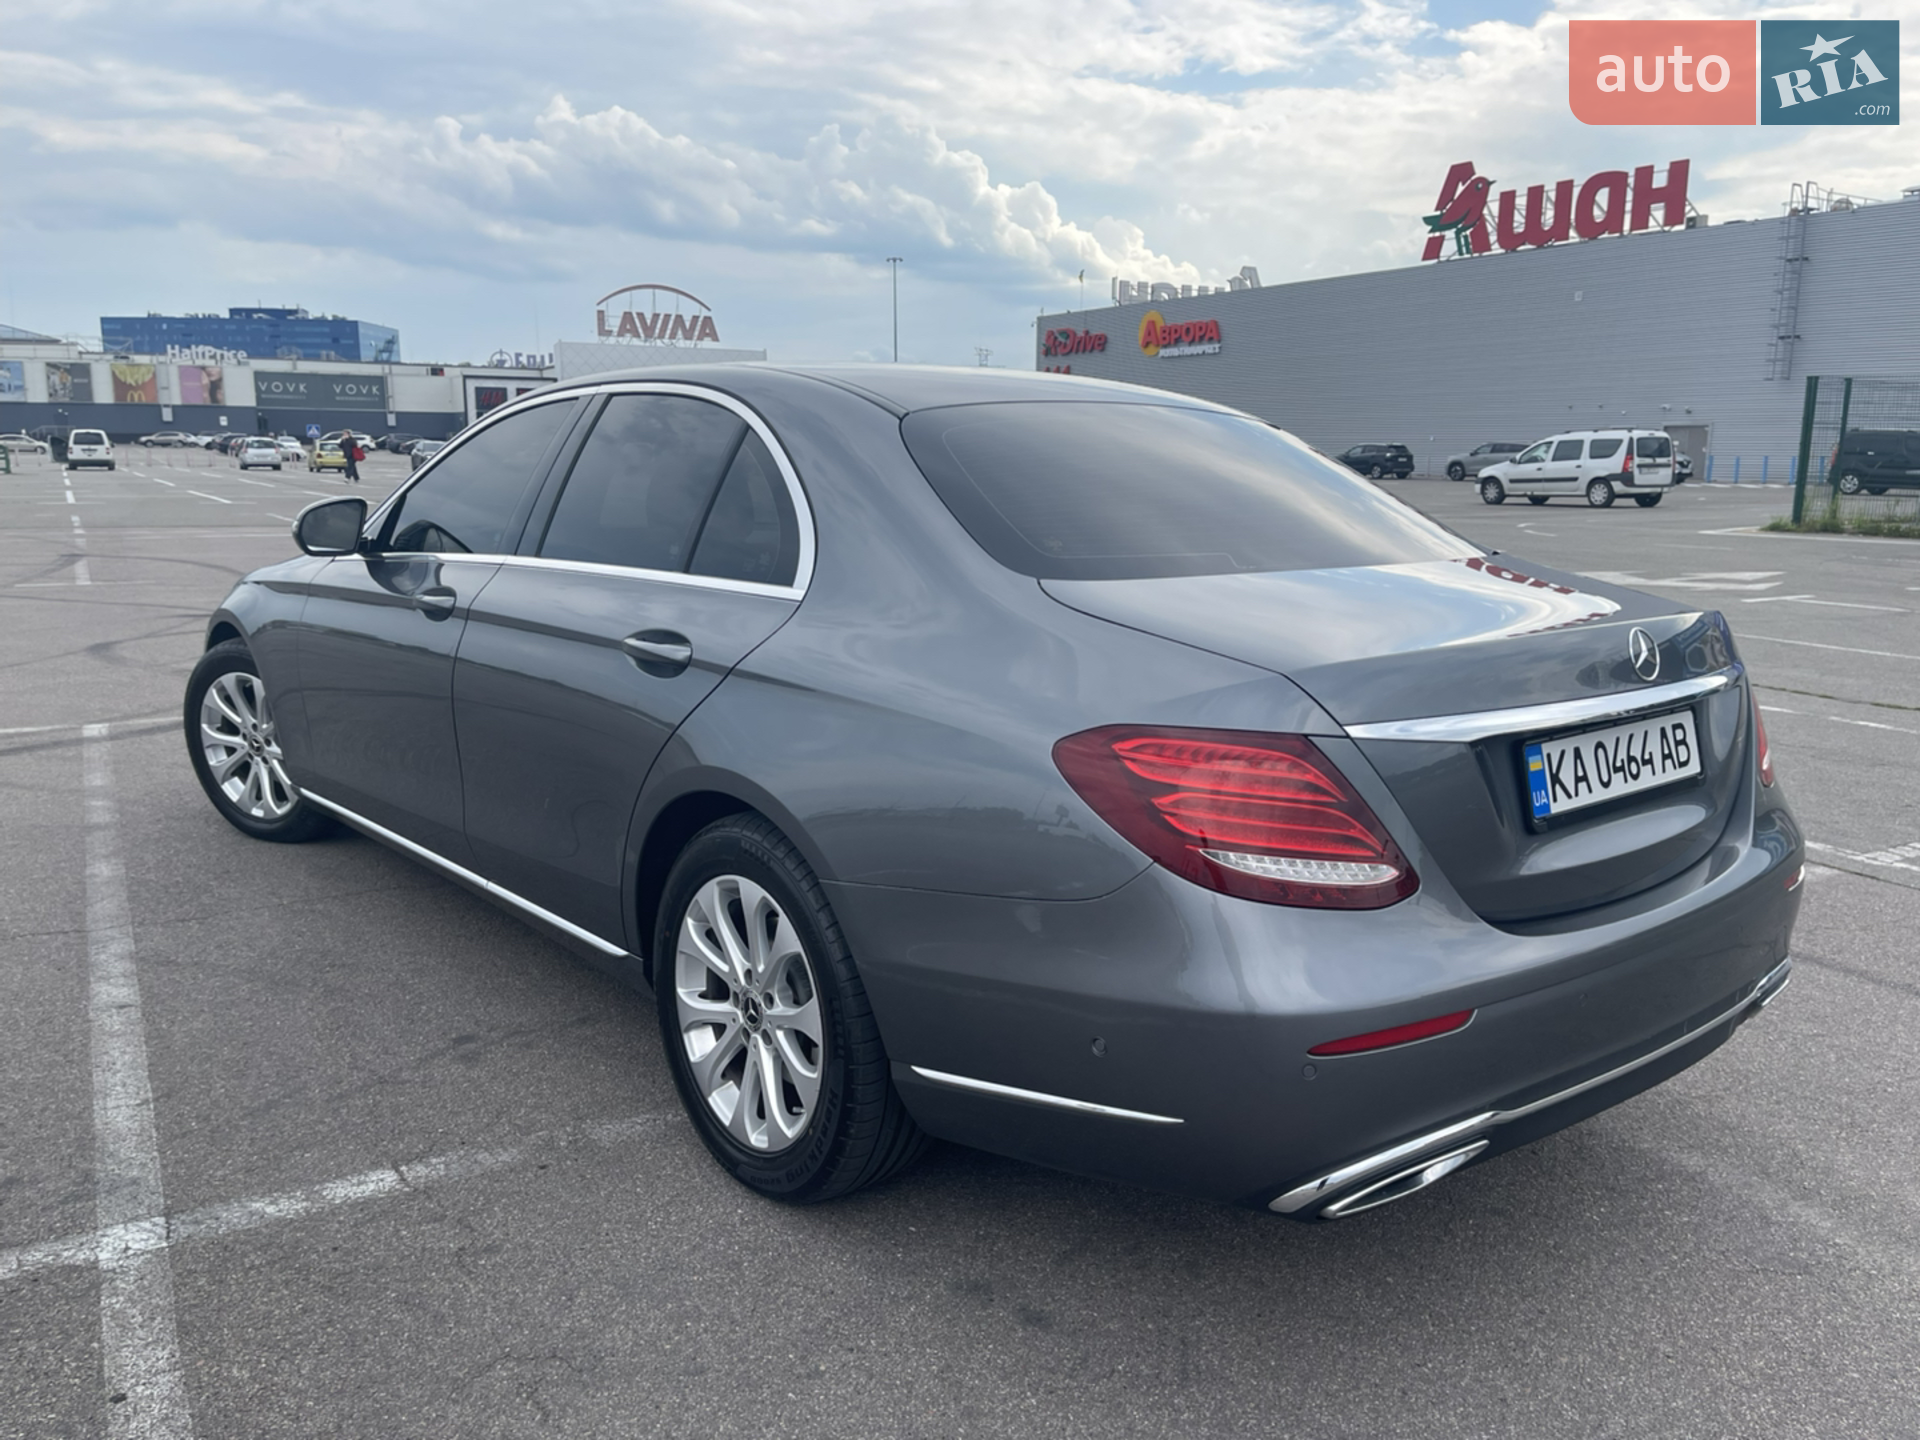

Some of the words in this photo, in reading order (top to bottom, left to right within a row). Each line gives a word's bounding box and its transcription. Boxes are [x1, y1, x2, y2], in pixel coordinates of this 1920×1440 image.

[596, 309, 720, 343] LAVINA
[166, 344, 248, 363] HalfPrice
[257, 380, 308, 394] VOVK
[332, 383, 381, 396] VOVK
[1546, 746, 1593, 804] KA
[1594, 729, 1656, 790] 0464
[1660, 722, 1691, 774] AB
[1532, 789, 1549, 807] UA
